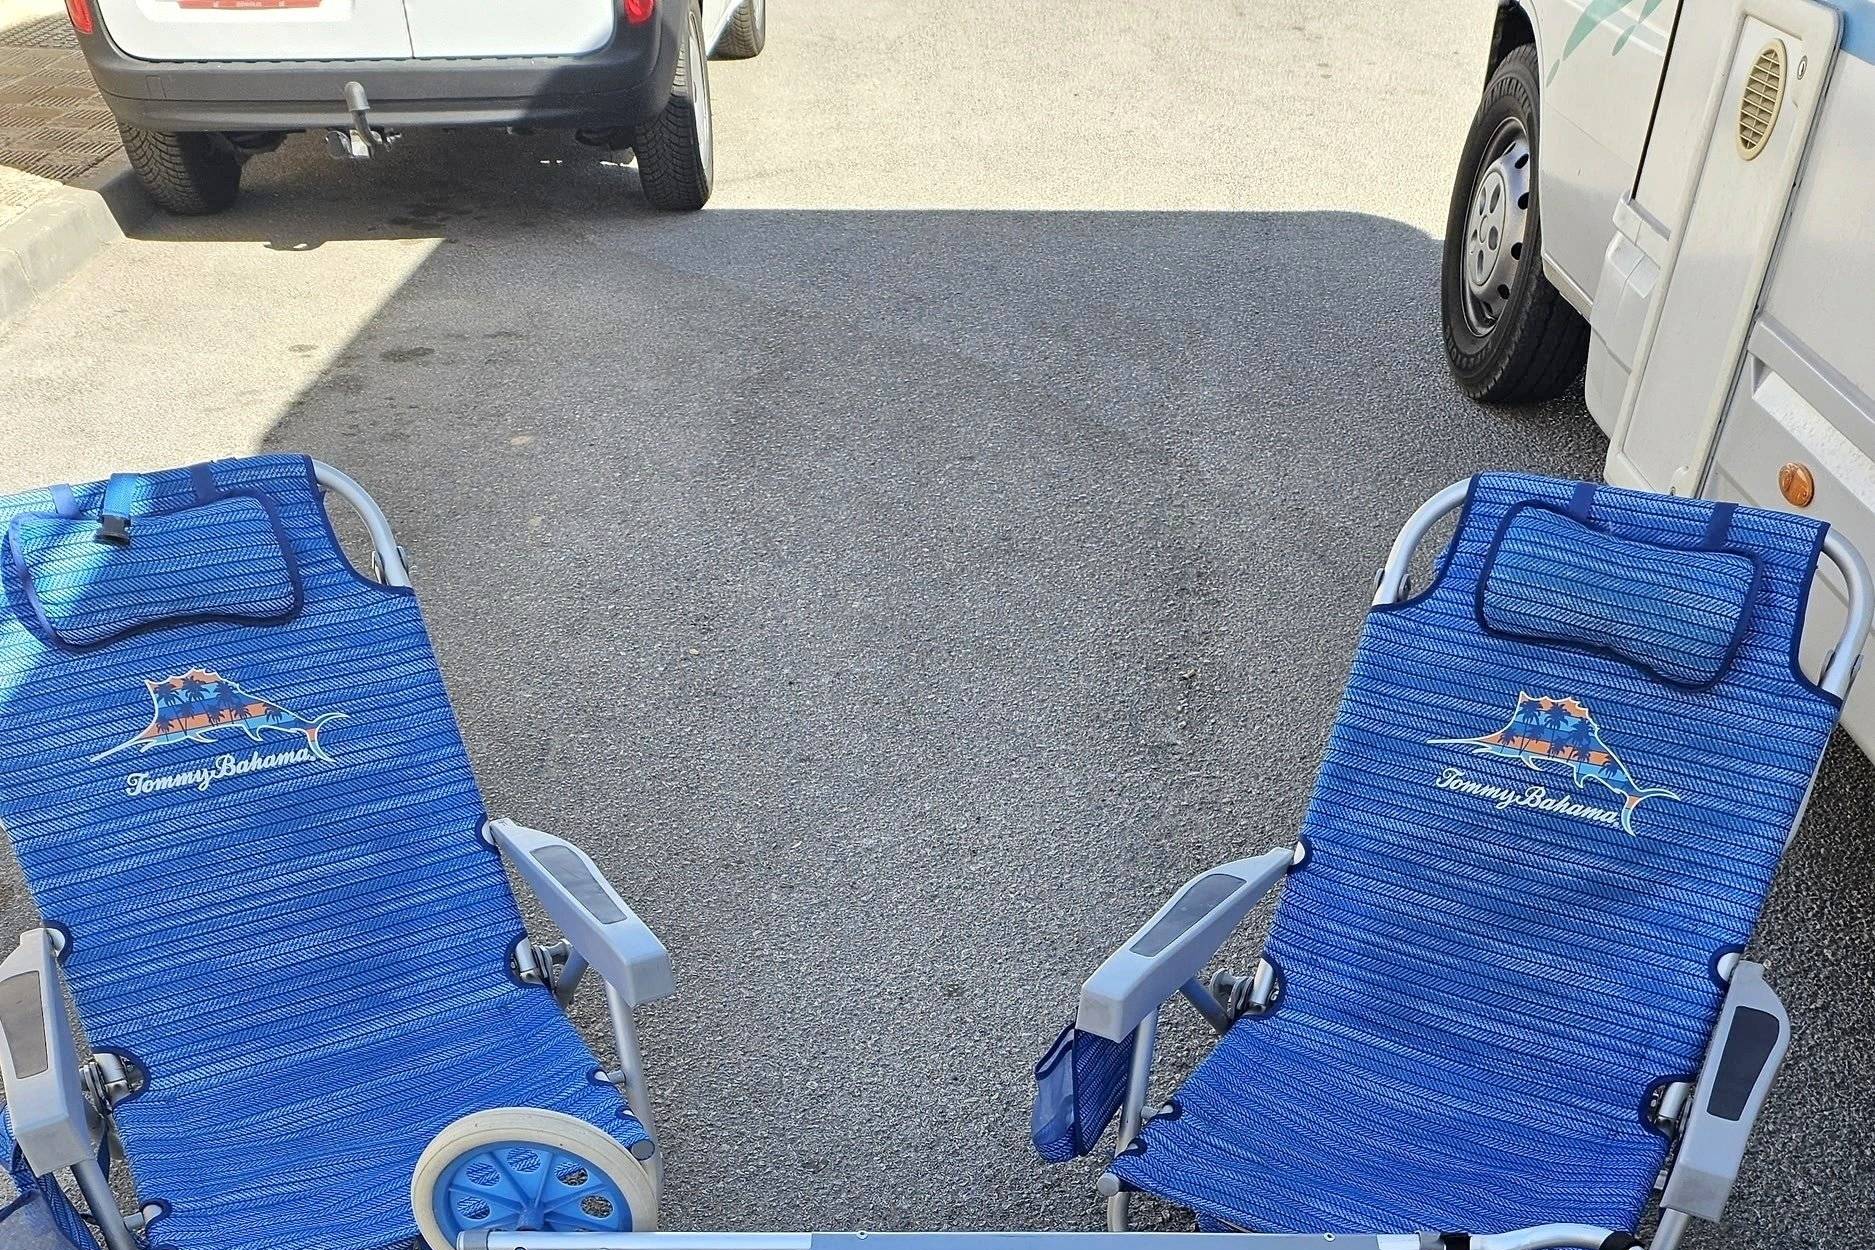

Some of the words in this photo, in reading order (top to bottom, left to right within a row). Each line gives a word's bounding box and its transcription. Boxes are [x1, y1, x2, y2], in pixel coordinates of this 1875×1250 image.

[127, 766, 216, 797] Tommy
[209, 747, 313, 780] Bahama
[1436, 768, 1520, 810] Tommy
[1515, 786, 1621, 825] Bahama
